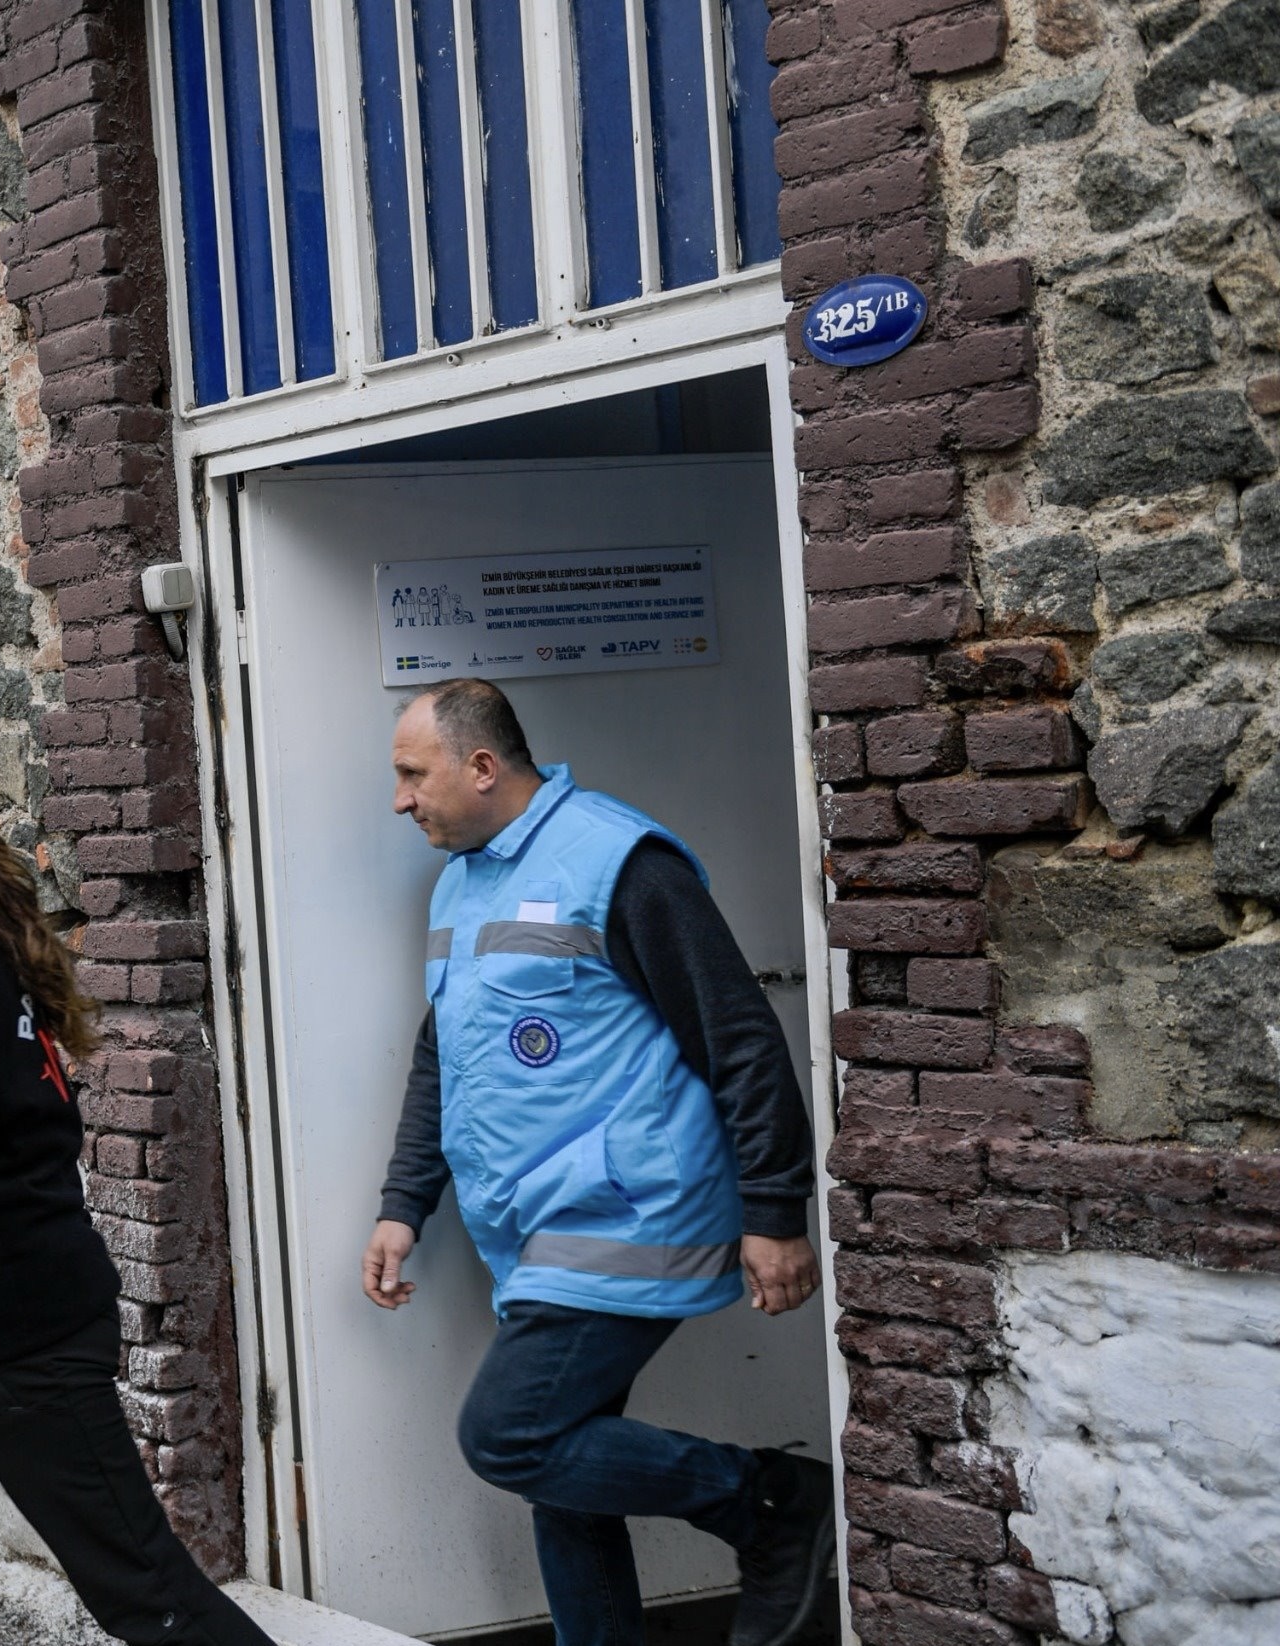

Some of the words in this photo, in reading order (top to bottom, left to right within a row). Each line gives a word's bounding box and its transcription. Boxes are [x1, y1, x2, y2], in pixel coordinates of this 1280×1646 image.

[813, 291, 909, 343] 325/1B
[483, 586, 505, 597] KADIN
[506, 586, 516, 595] VE
[603, 580, 612, 589] VE
[613, 578, 638, 589] HİZMET
[505, 605, 554, 616] METROPOLITAN
[644, 599, 653, 608] OF
[654, 598, 678, 607] HEALTH
[486, 620, 512, 630] WOMEN
[513, 619, 527, 629] AND
[528, 617, 576, 627] REPRODUCTIVE
[577, 615, 602, 625] HEALTH
[603, 612, 649, 623] CONSULTATION
[650, 611, 663, 621] AND
[664, 610, 689, 619] SERVICE
[555, 644, 586, 654] SAĞLIK
[619, 639, 661, 652] TAPV
[421, 660, 452, 669] Sverige
